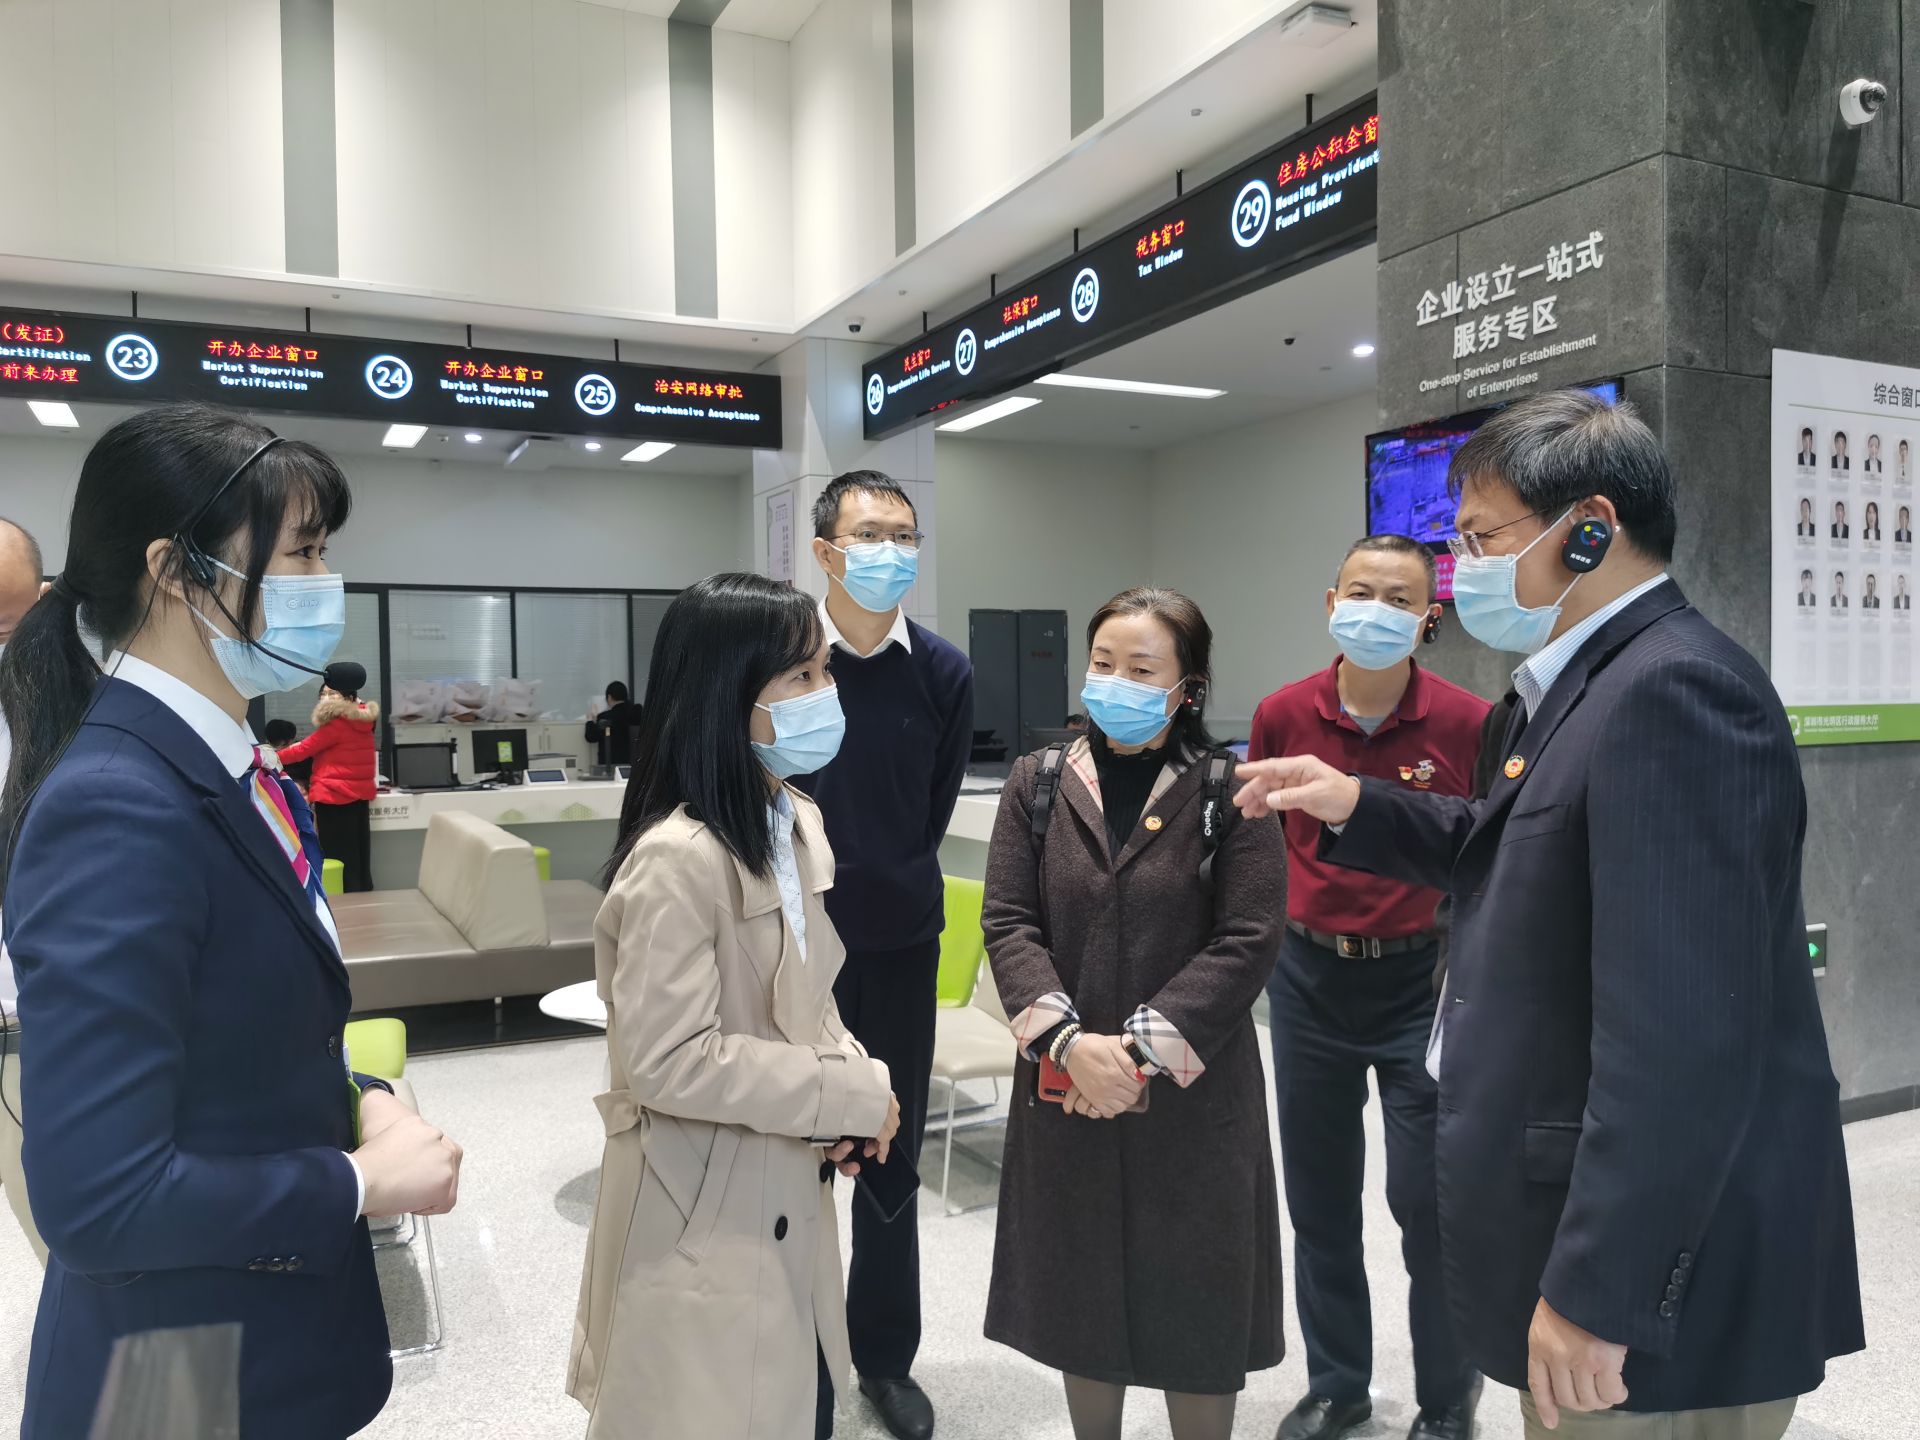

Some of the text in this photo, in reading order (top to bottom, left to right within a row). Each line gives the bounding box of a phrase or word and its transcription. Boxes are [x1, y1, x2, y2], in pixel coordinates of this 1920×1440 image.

[1275, 149, 1380, 211] Housing Provident
[1239, 196, 1263, 233] 29
[1275, 190, 1342, 231] Fund Window
[1136, 219, 1185, 259] 税务窗口
[1138, 248, 1184, 278] Tax Window
[1416, 230, 1604, 327] 企业设立一站式
[1077, 284, 1095, 311] 28
[1452, 295, 1558, 360] 服务专区
[117, 346, 149, 369] 23
[207, 340, 319, 362] 开办企业窗口
[959, 341, 972, 365] 27
[0, 363, 79, 382] 前来办理
[202, 360, 324, 379] Market Supervision
[445, 361, 544, 382] 开办企业窗口
[1419, 334, 1597, 393] One-stop Service for Establishment
[220, 375, 308, 391] Certification
[376, 366, 405, 388] 24
[440, 379, 549, 398] Market Supervision
[1466, 371, 1539, 399] of Enterprises
[456, 393, 535, 409] Certification
[583, 385, 608, 406] 25
[655, 380, 743, 399] 治安网络审批
[870, 383, 881, 406] 26
[634, 402, 704, 417] Comprehensive
